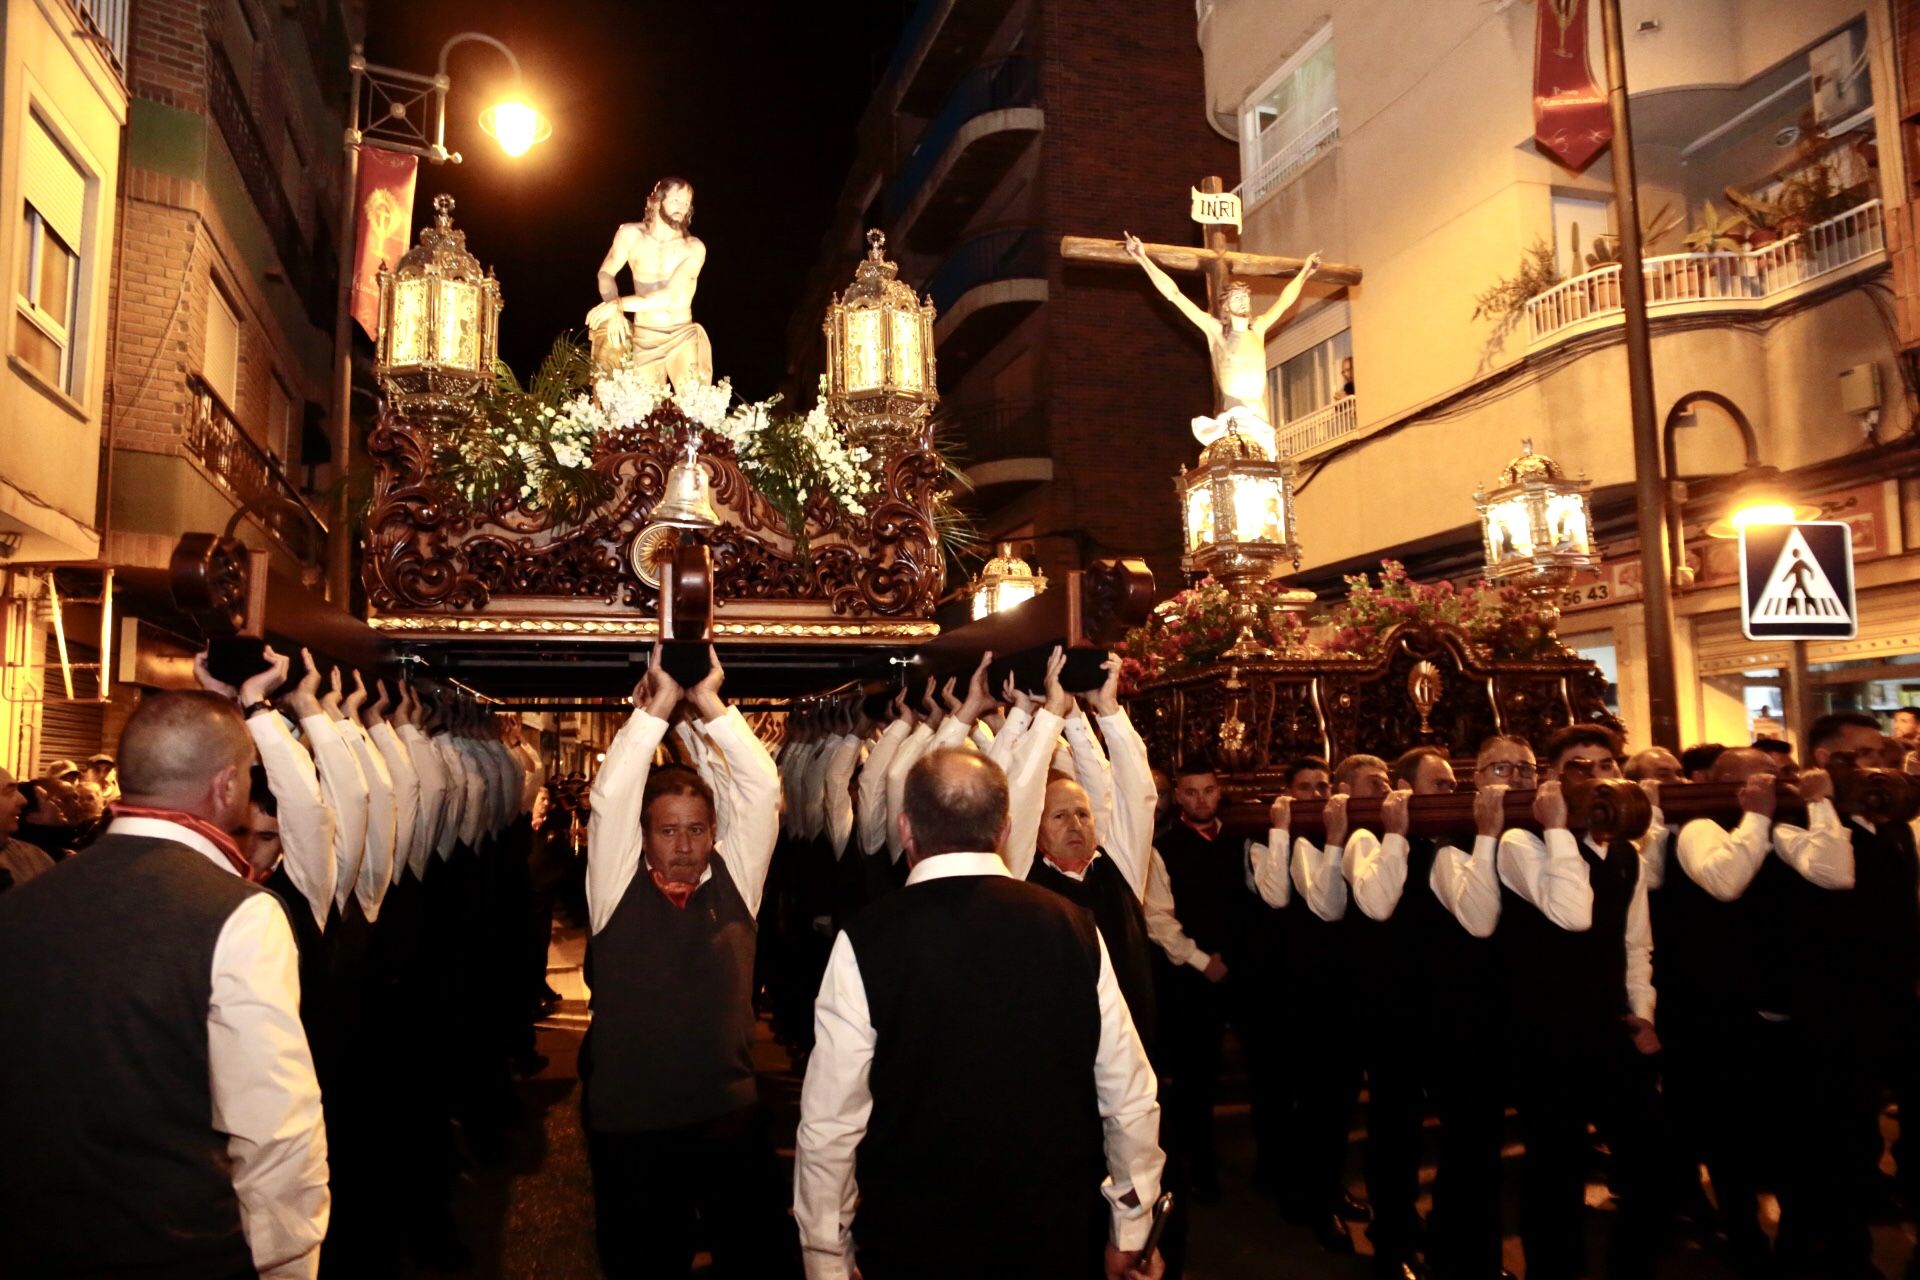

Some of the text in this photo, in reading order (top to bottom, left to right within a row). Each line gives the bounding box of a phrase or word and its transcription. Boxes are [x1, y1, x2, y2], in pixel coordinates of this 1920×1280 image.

[1201, 199, 1235, 217] INRI
[1563, 590, 1582, 607] 56
[1587, 585, 1608, 601] 43
